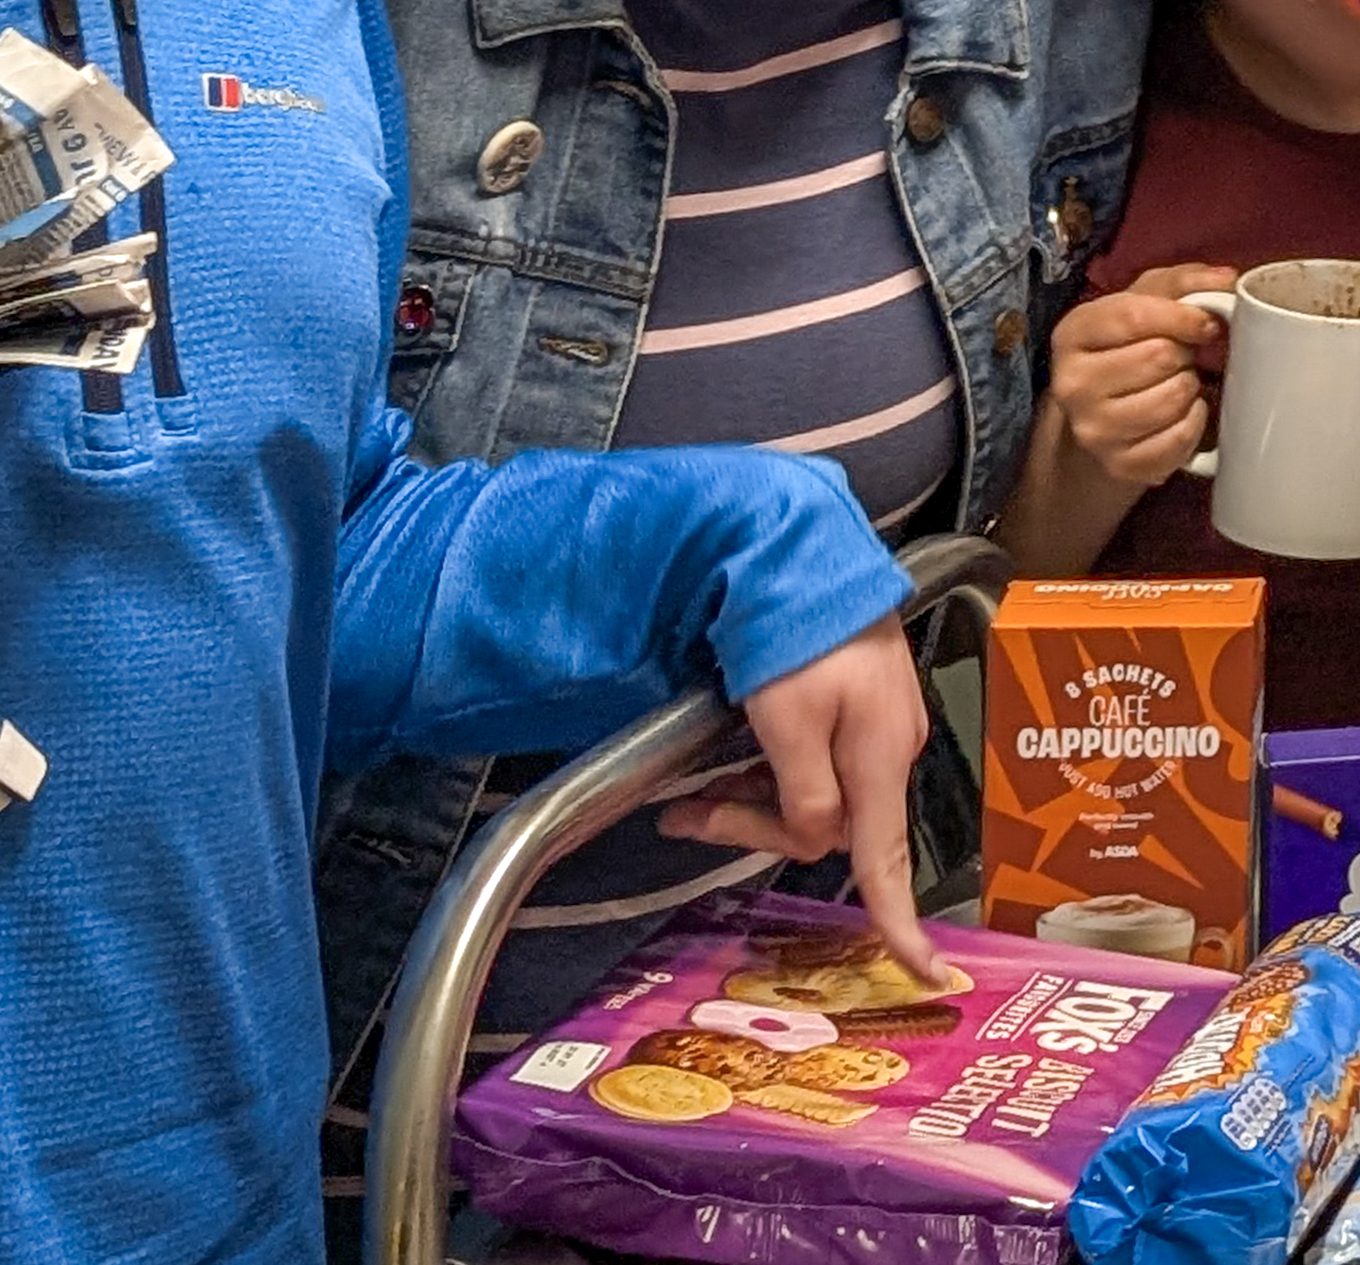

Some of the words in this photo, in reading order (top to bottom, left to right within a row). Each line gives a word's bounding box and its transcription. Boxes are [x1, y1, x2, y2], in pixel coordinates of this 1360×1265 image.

[1065, 681, 1081, 699] 8
[1082, 663, 1177, 699] SACHETS
[1089, 687, 1151, 727] CAFÉ
[1016, 725, 1221, 760] CAPPUCCINO
[1114, 783, 1139, 799] HOT
[1140, 759, 1177, 793] WATER
[986, 974, 1065, 1042] FAVOURITES
[991, 1056, 1096, 1139] BISCUIT
